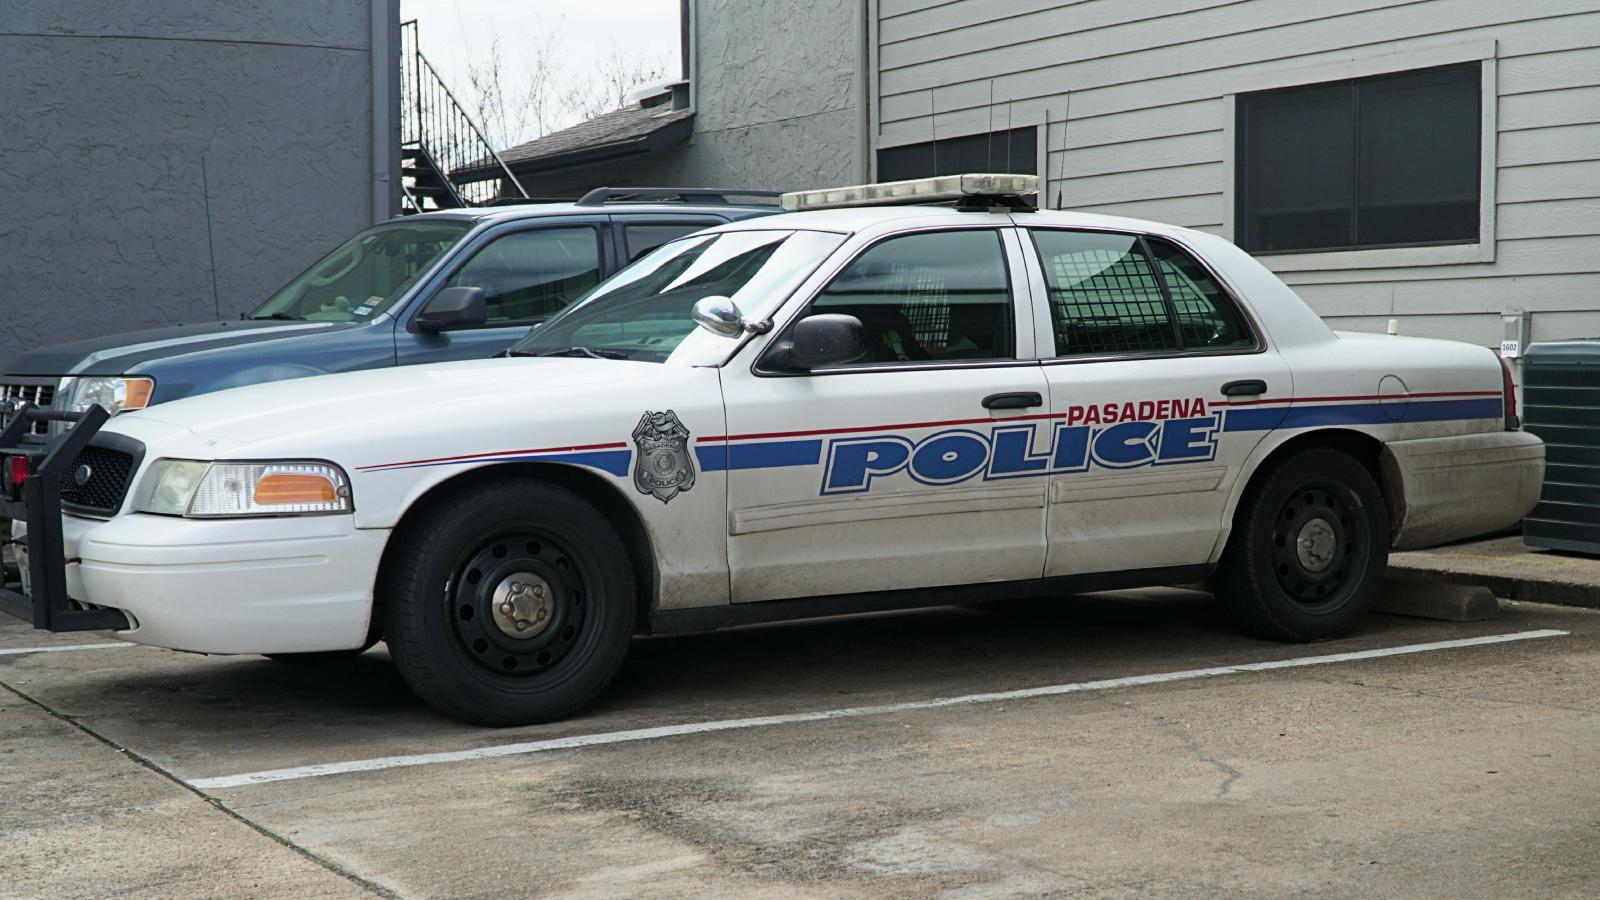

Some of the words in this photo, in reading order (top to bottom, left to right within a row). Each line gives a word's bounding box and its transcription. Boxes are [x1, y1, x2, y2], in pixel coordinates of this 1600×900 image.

[1503, 343, 1517, 351] 1602
[1068, 397, 1207, 426] PASADENA
[820, 411, 1221, 495] POLICE
